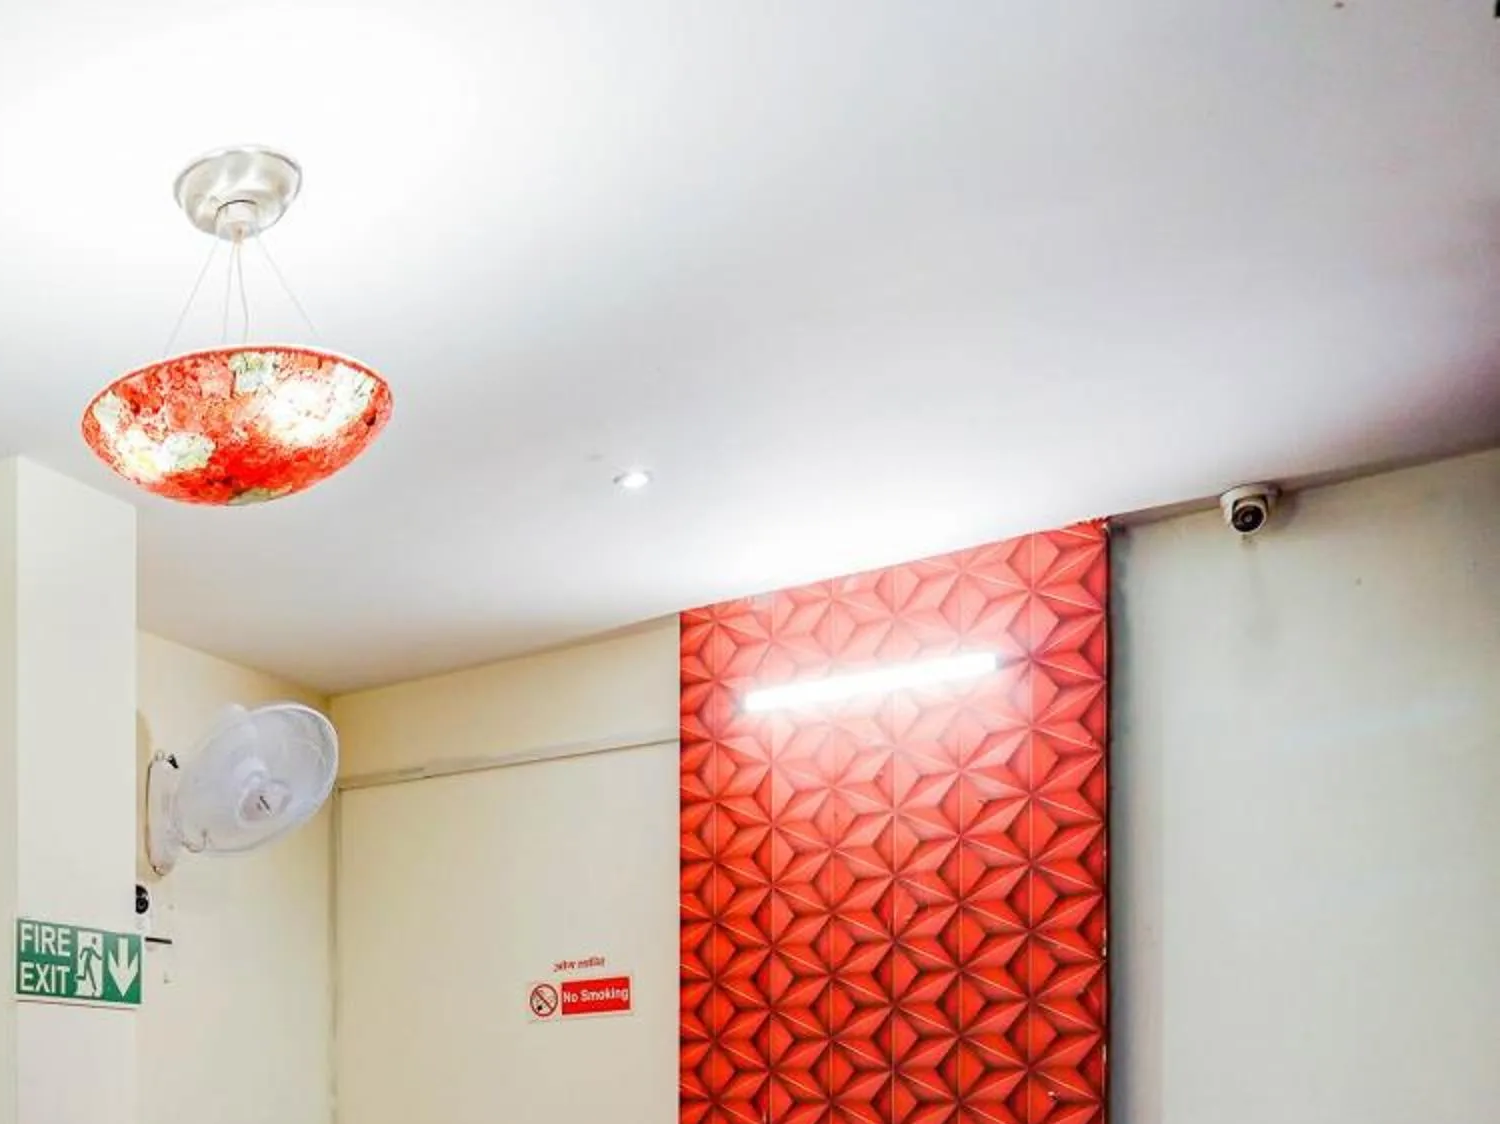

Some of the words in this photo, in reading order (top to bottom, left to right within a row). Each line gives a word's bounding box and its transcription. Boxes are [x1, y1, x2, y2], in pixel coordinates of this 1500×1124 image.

[20, 923, 71, 957] FIRE
[20, 961, 70, 994] EXIT
[563, 991, 578, 1003] No
[581, 988, 628, 1003] Smoking
